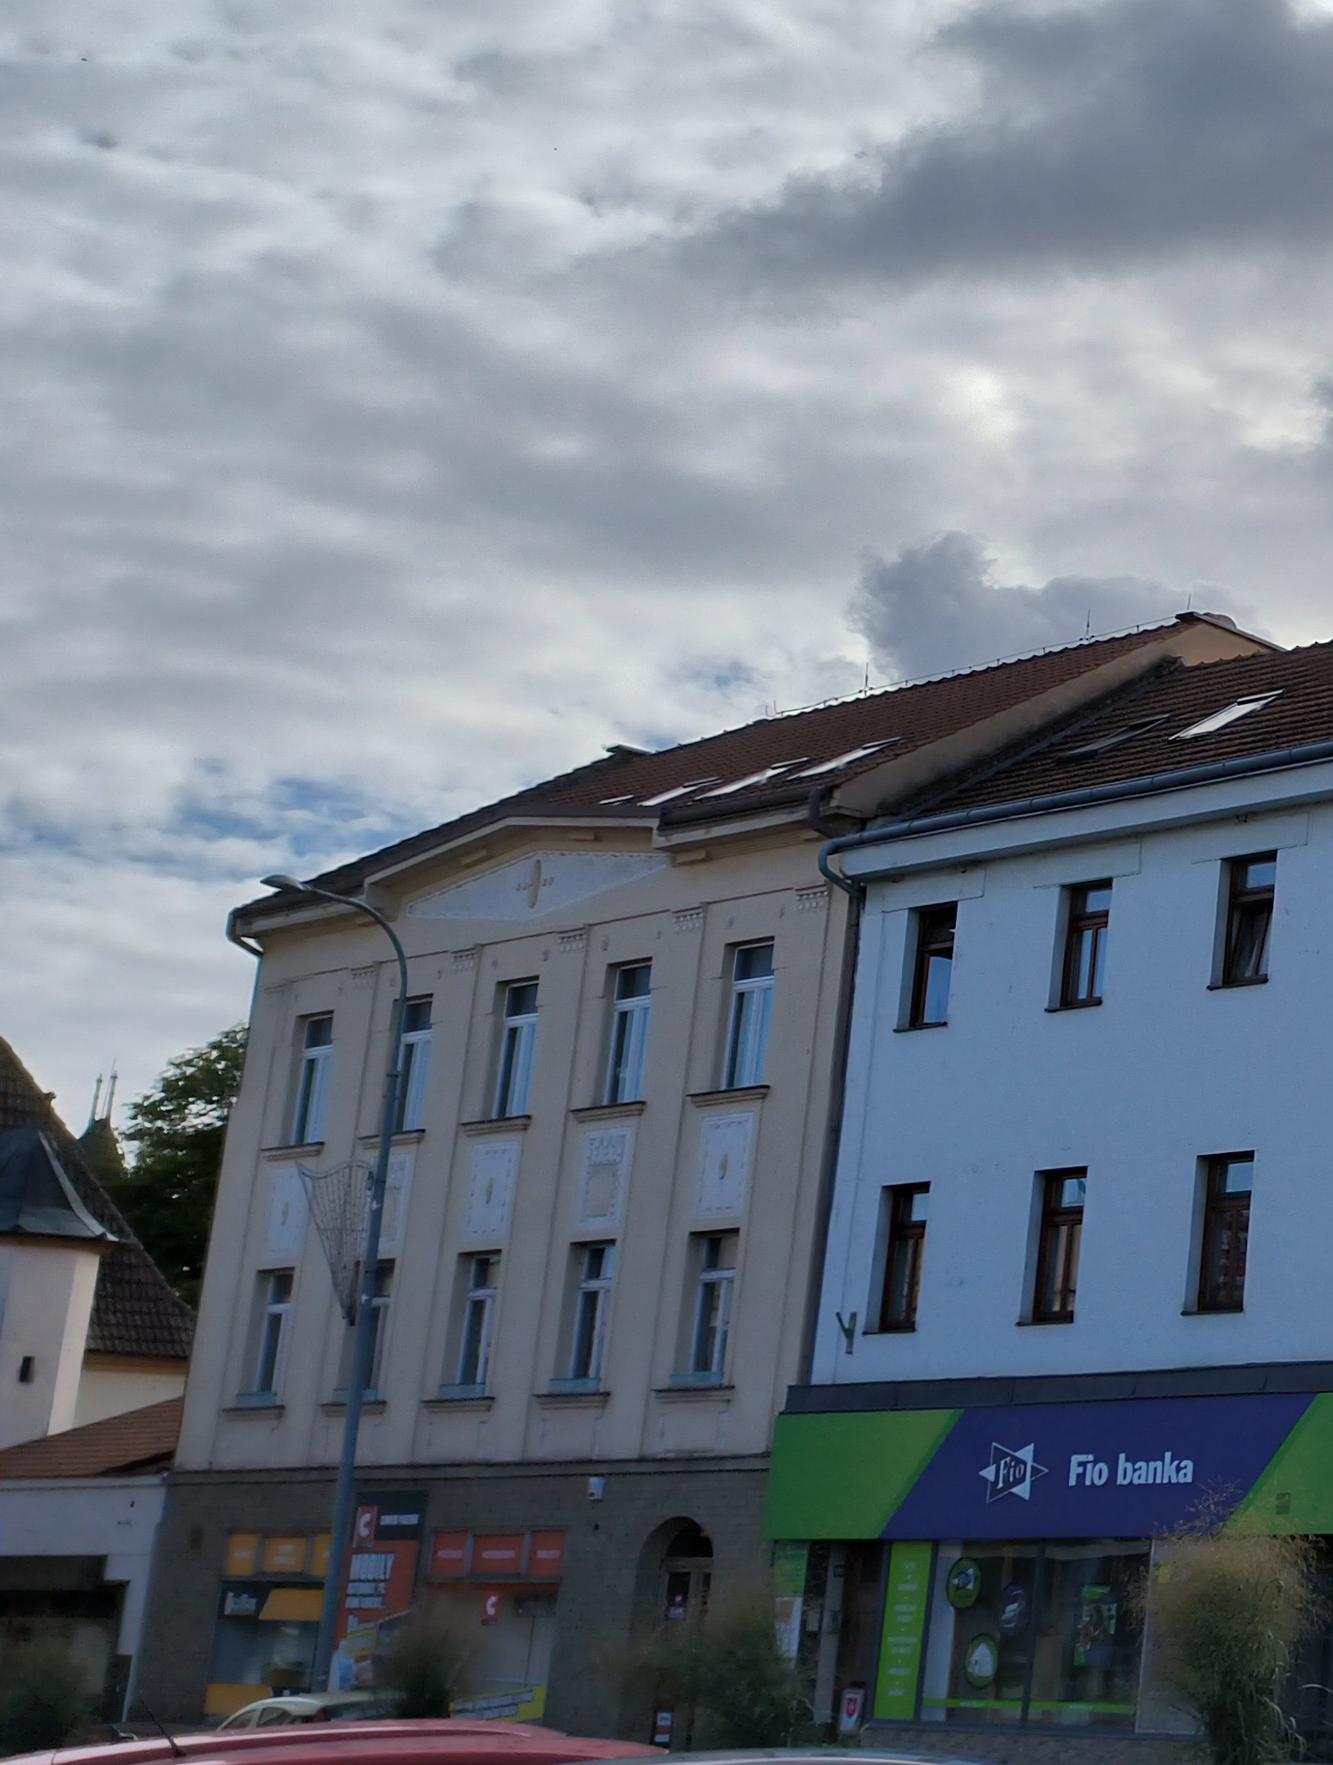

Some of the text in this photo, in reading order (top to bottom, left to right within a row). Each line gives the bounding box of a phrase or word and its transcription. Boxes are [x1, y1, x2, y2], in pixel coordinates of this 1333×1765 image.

[996, 1450, 1194, 1489] Fio Fio banka
